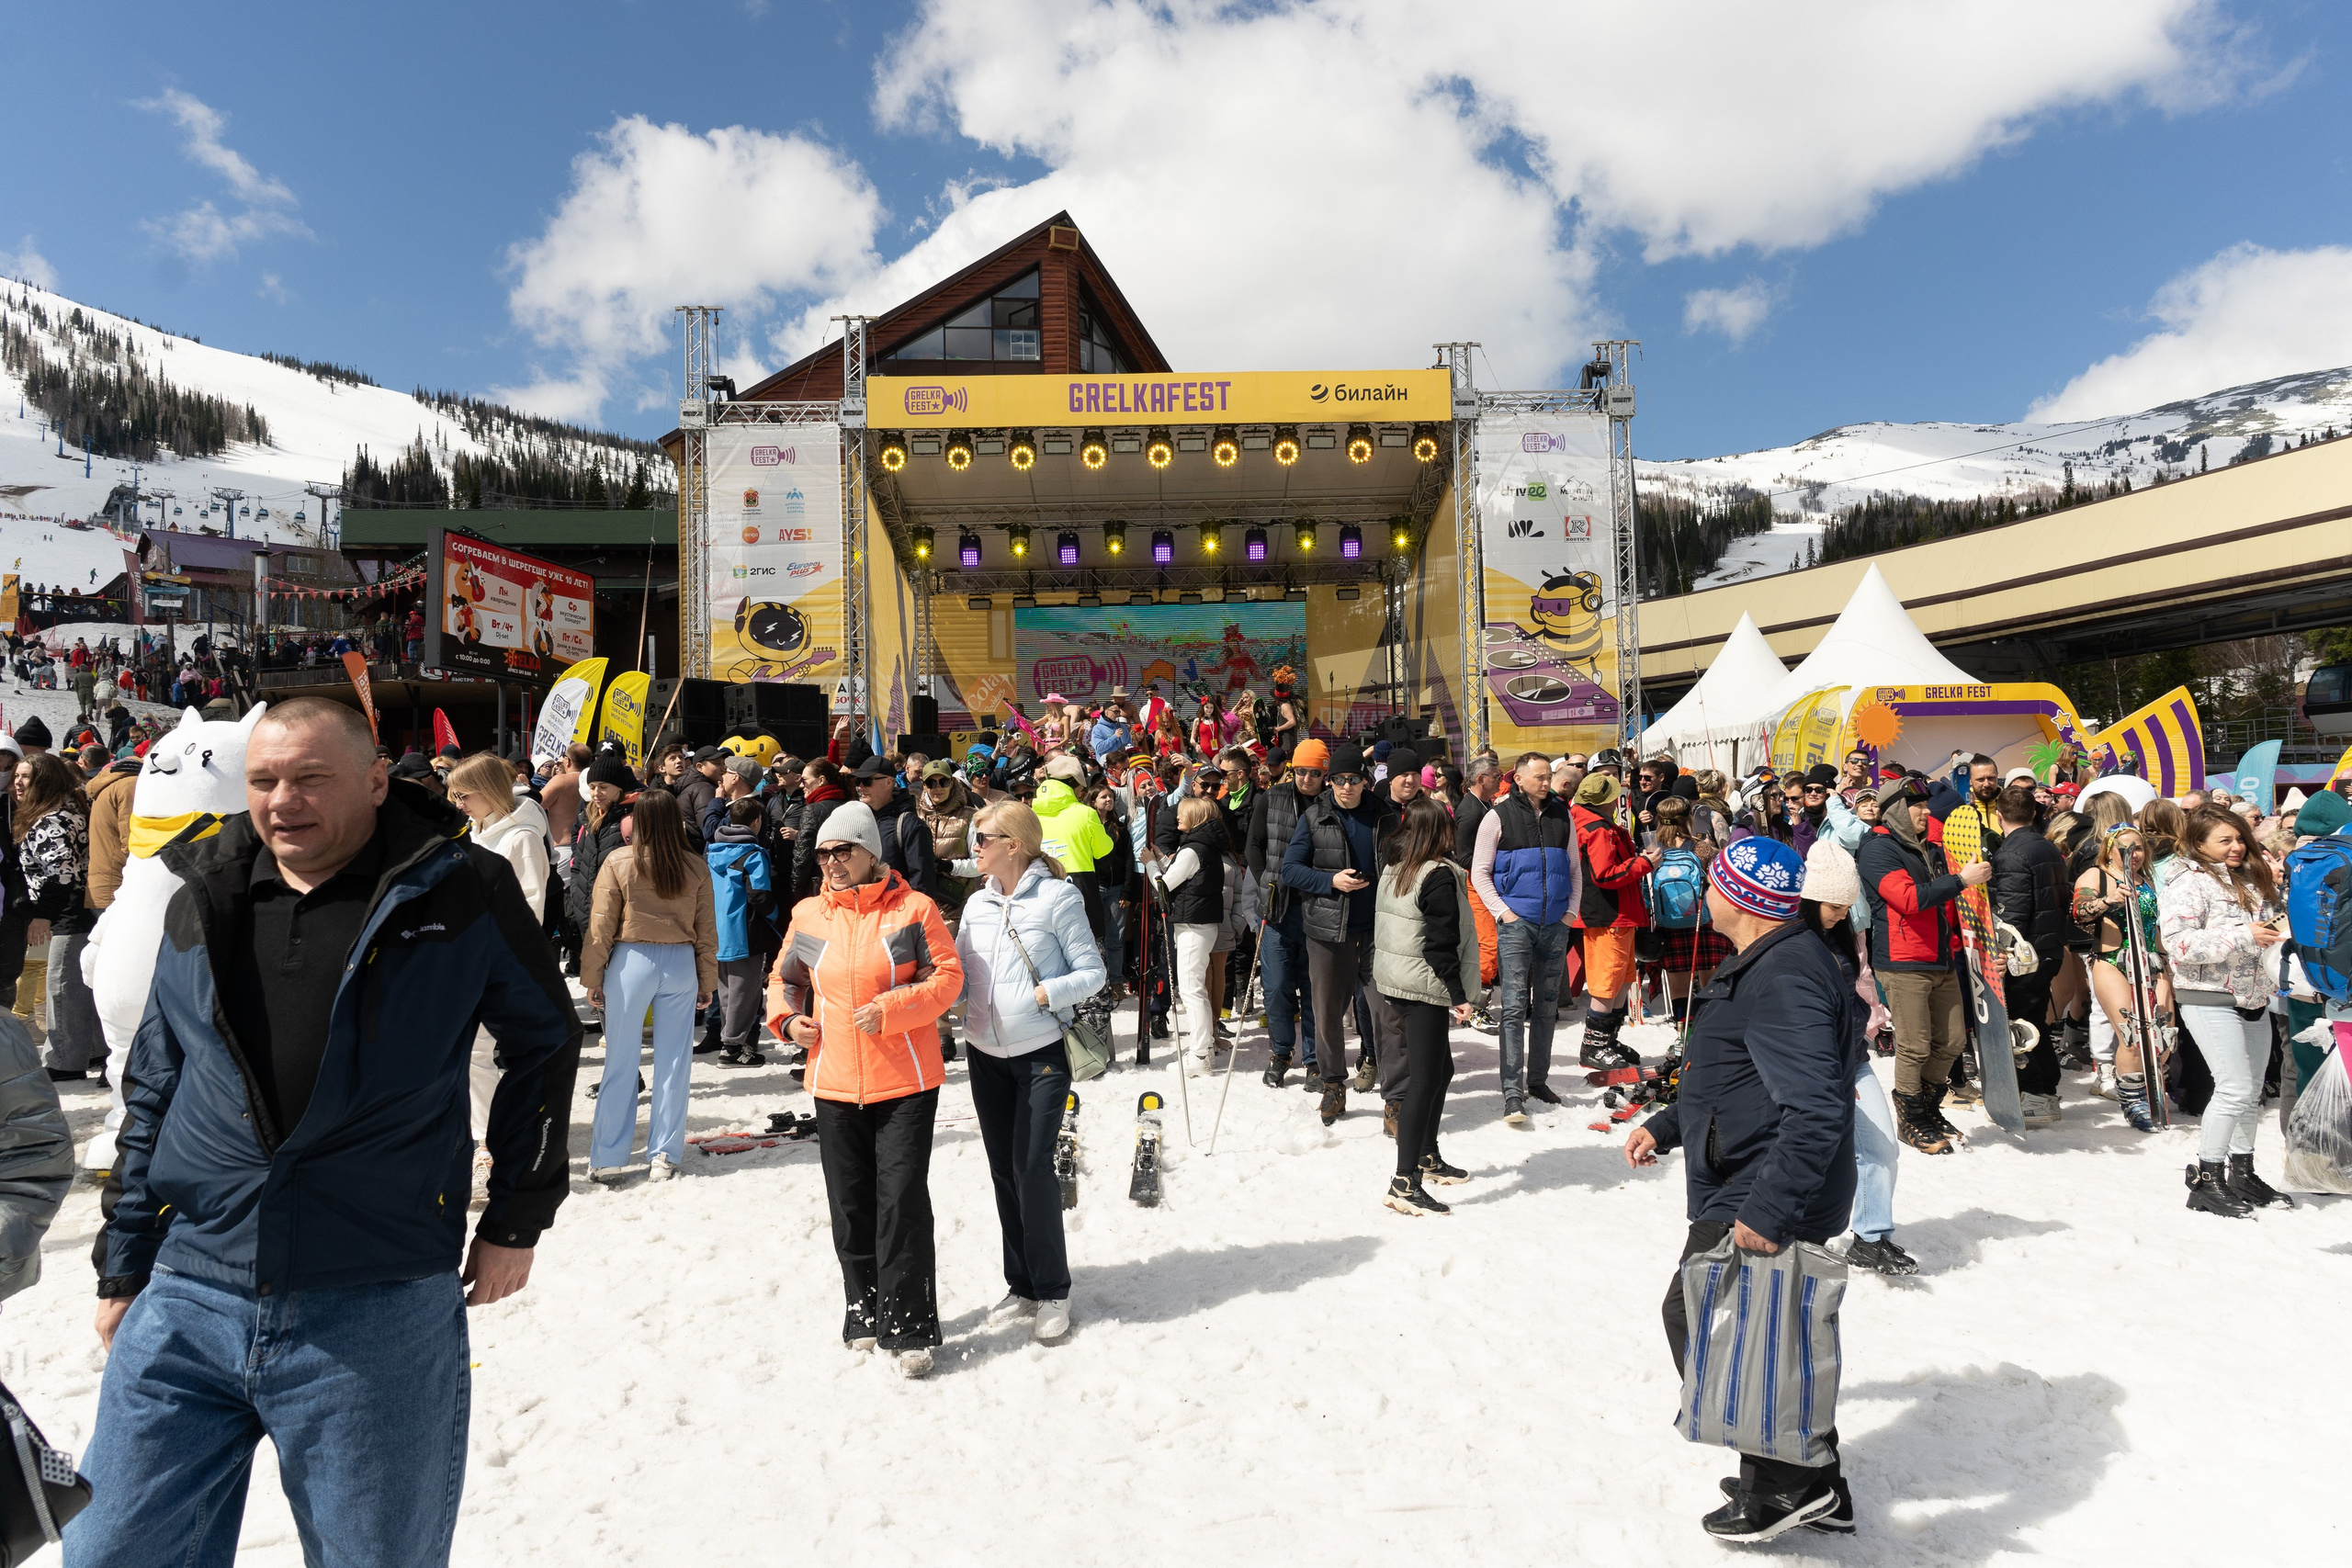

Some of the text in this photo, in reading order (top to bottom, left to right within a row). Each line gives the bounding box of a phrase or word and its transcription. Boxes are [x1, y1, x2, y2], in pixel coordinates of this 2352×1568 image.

[910, 389, 941, 400] GRELKA
[1069, 381, 1232, 412] GRELKAFEST
[1334, 384, 1408, 402] билайн
[910, 400, 932, 412] FEST
[755, 448, 776, 457] GRELKA
[755, 456, 770, 464] FEST
[779, 528, 812, 541] AYS!
[452, 542, 589, 590] СОГРЕВАЕМ В ШЕРЕГЕШЕ УЖЕ 10 ЛЕТ!
[750, 568, 776, 576] 2ГИС
[498, 586, 510, 597] Пн.
[490, 596, 517, 607] квартирник
[568, 601, 579, 612] Ср.
[458, 653, 472, 662] 10:00
[480, 657, 491, 665] 0:00
[507, 650, 542, 671] GRELKA
[1042, 660, 1087, 679] GRELKA
[967, 674, 1004, 711] Cola
[1044, 678, 1073, 694] FEST
[1925, 685, 1992, 699] GRELKA FEST
[614, 696, 625, 706] FEST
[1011, 757, 1031, 773] SCOTT
[1962, 929, 1989, 1024] HEAD
